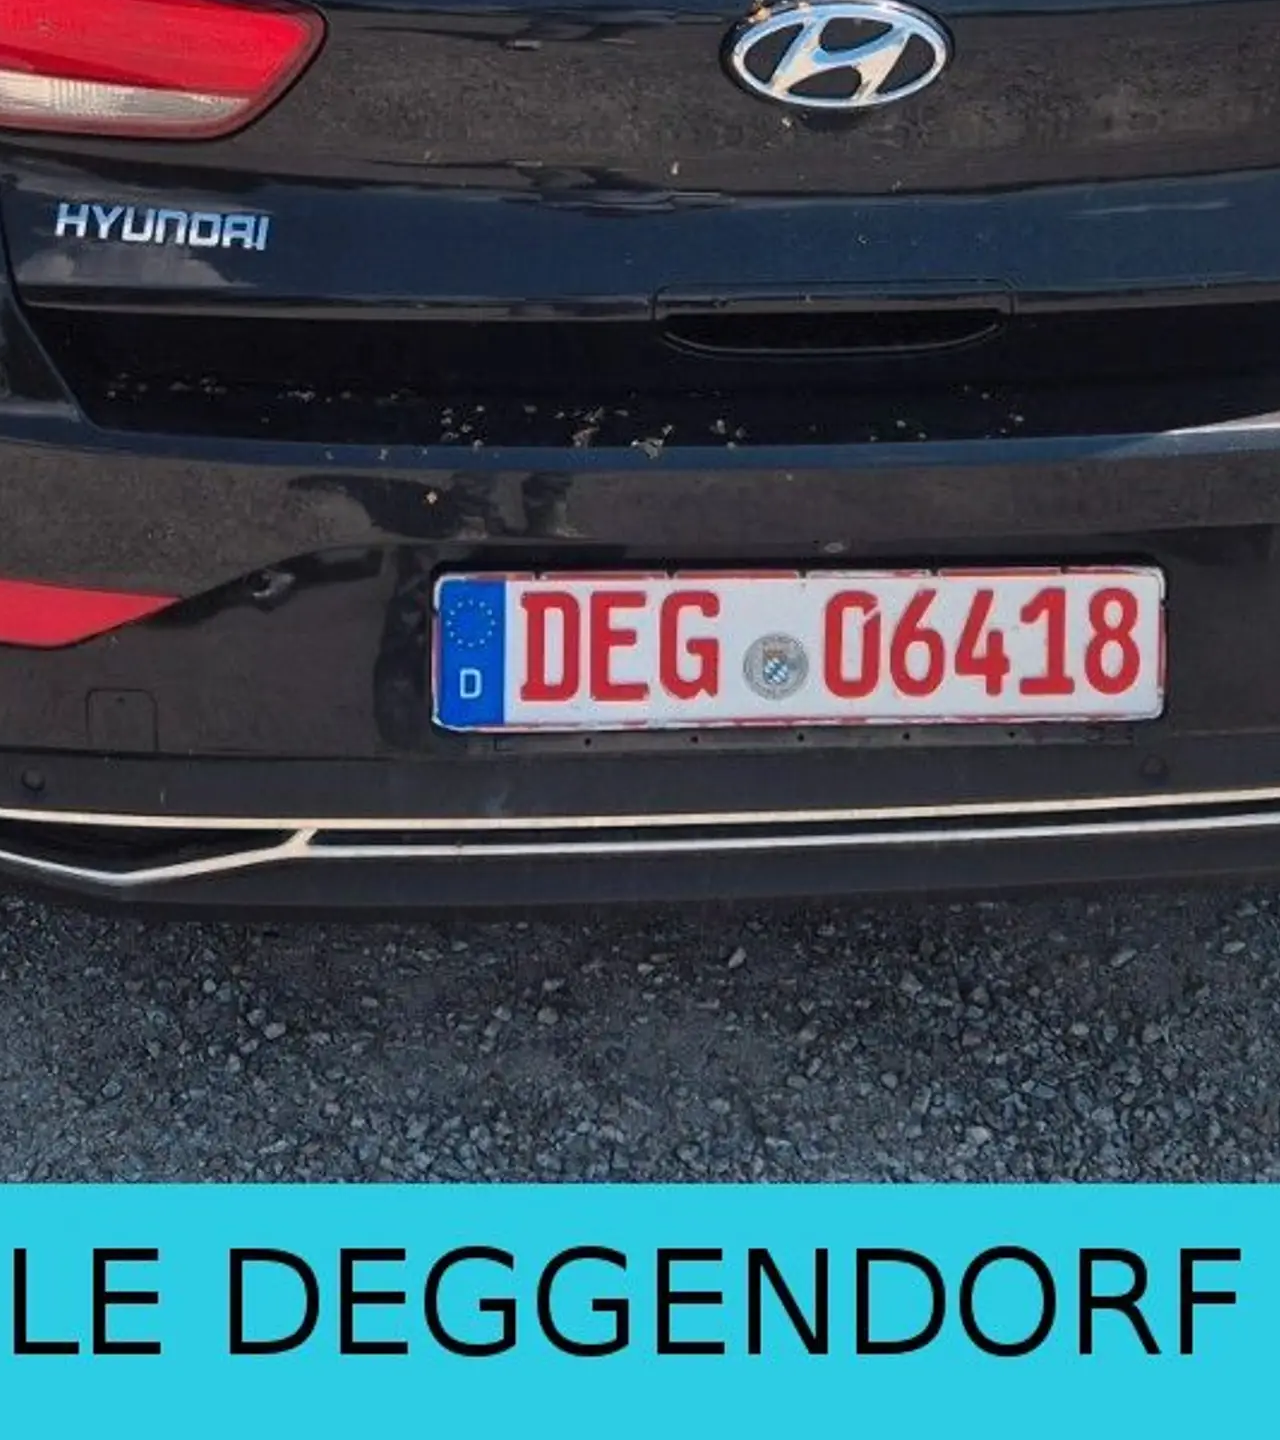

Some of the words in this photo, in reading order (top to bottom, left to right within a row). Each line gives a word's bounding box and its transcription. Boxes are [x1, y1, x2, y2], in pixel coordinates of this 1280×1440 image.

[54, 202, 270, 251] HYUNDAI
[520, 590, 720, 702] DEG
[823, 587, 1141, 698] 06418
[459, 667, 483, 699] D
